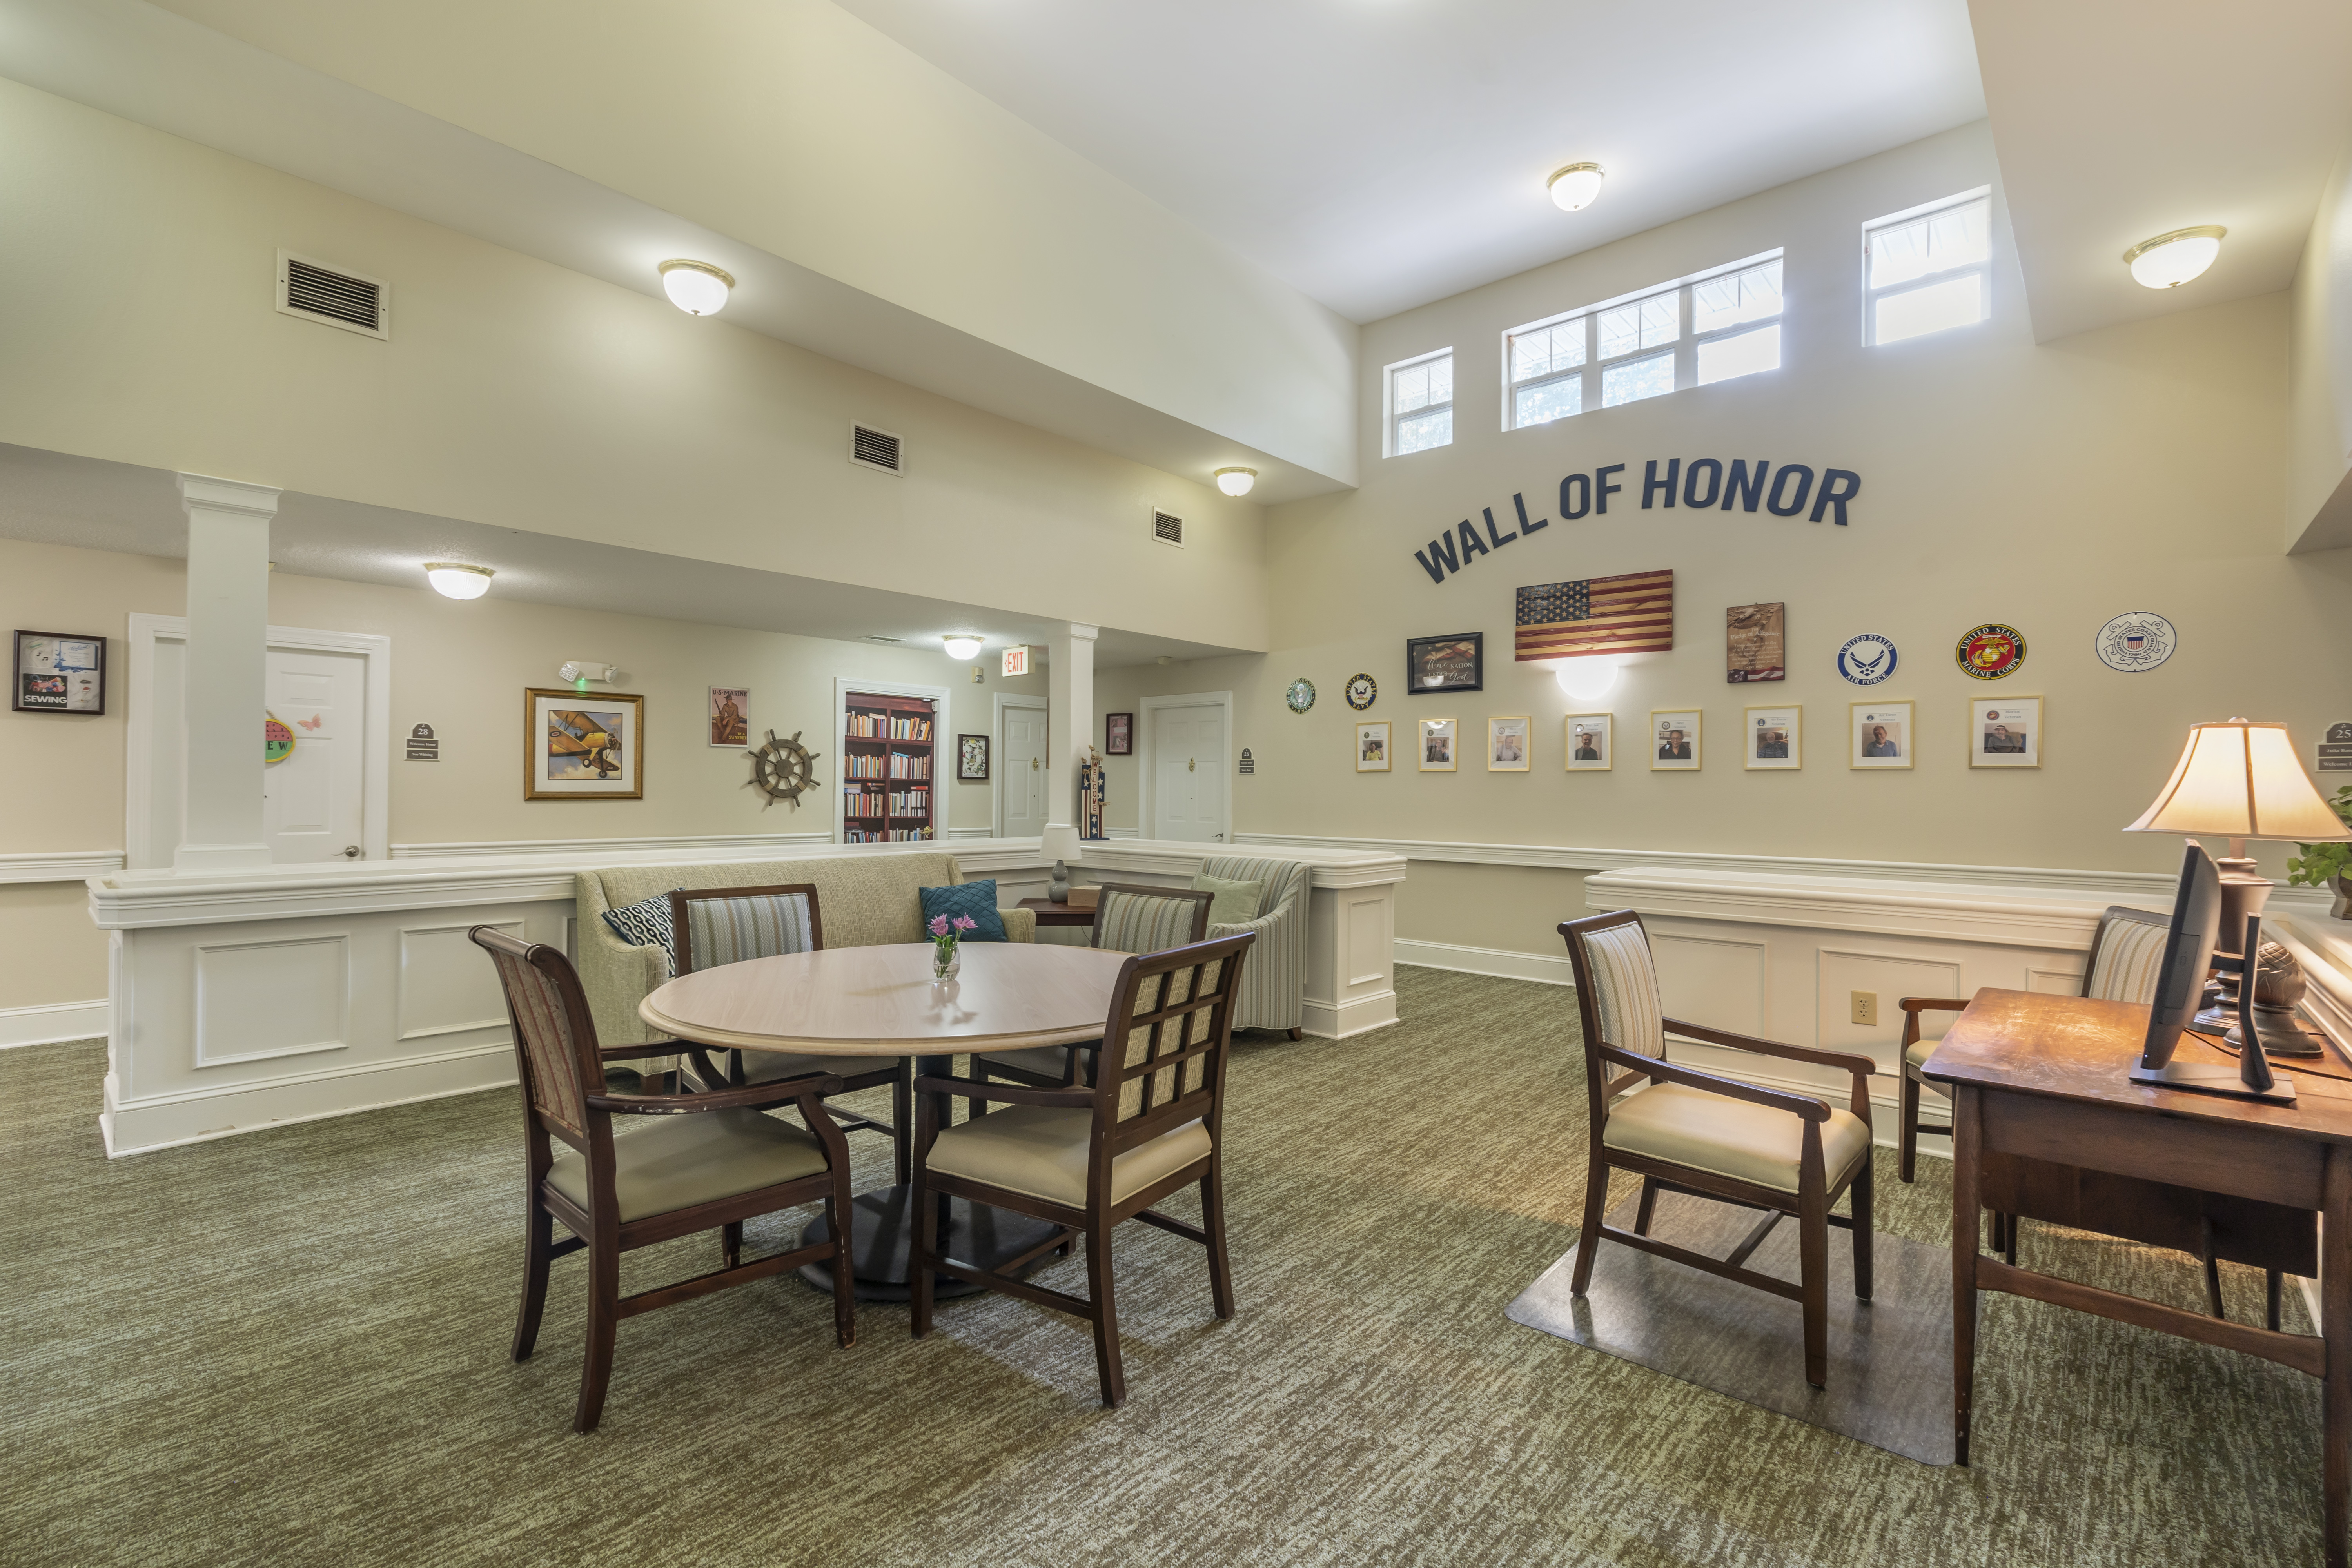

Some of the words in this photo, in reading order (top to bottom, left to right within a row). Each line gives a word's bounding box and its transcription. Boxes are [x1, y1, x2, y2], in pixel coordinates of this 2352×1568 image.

[1414, 492, 1549, 584] WALL
[1559, 463, 1625, 520] OF
[1641, 457, 1861, 526] HONOR
[1961, 628, 1989, 649] UNITED
[1995, 627, 2021, 646] STATES
[2118, 628, 2135, 640] STATES
[2136, 628, 2154, 637] COAST
[1840, 635, 1867, 654] UNITED
[1868, 635, 1895, 651] STATES
[2117, 641, 2127, 655] UNITED
[2143, 637, 2154, 653] GUARD
[1008, 652, 1024, 673] EXIT
[1428, 659, 1449, 671] One
[1962, 660, 1991, 677] MARINE
[1997, 657, 2020, 675] CORPS
[1447, 671, 1470, 685] God
[1846, 675, 1860, 684] AIR
[1862, 672, 1888, 685] FORCE
[1347, 675, 1360, 696] UNITED
[1363, 675, 1377, 695] STATES
[24, 695, 68, 704] SEWING
[2336, 730, 2351, 738] 25
